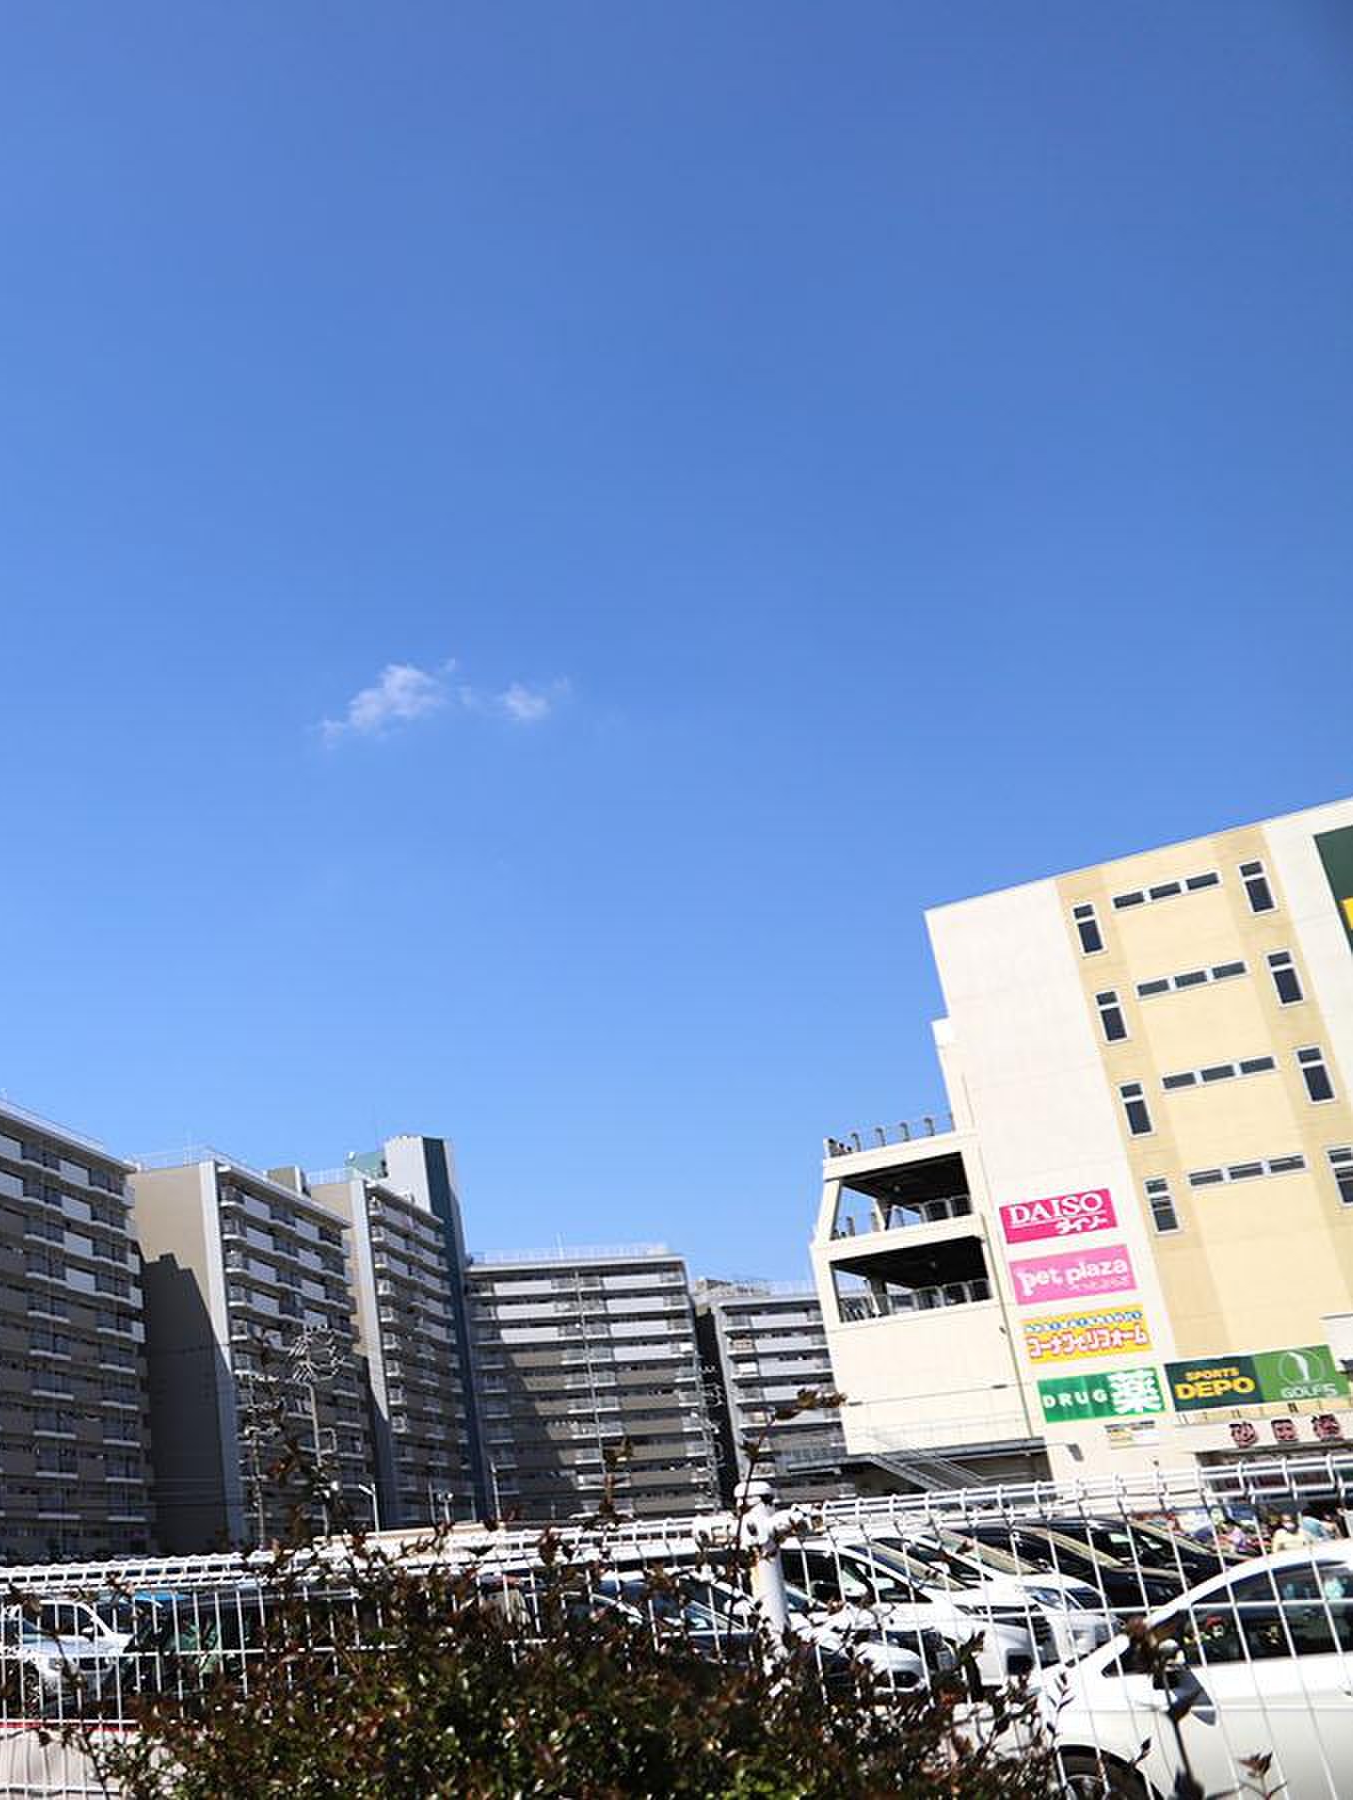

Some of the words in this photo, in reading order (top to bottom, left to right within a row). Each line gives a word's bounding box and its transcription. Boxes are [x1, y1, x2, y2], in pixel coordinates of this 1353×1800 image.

[1008, 1193, 1103, 1225] DAISO
[1016, 1267, 1063, 1297] pet
[1064, 1258, 1128, 1286] plaza
[1184, 1367, 1240, 1381] SPORTS
[1042, 1389, 1108, 1409] DRUG
[1175, 1376, 1256, 1400] DEPO
[1280, 1383, 1338, 1399] GOLF5
